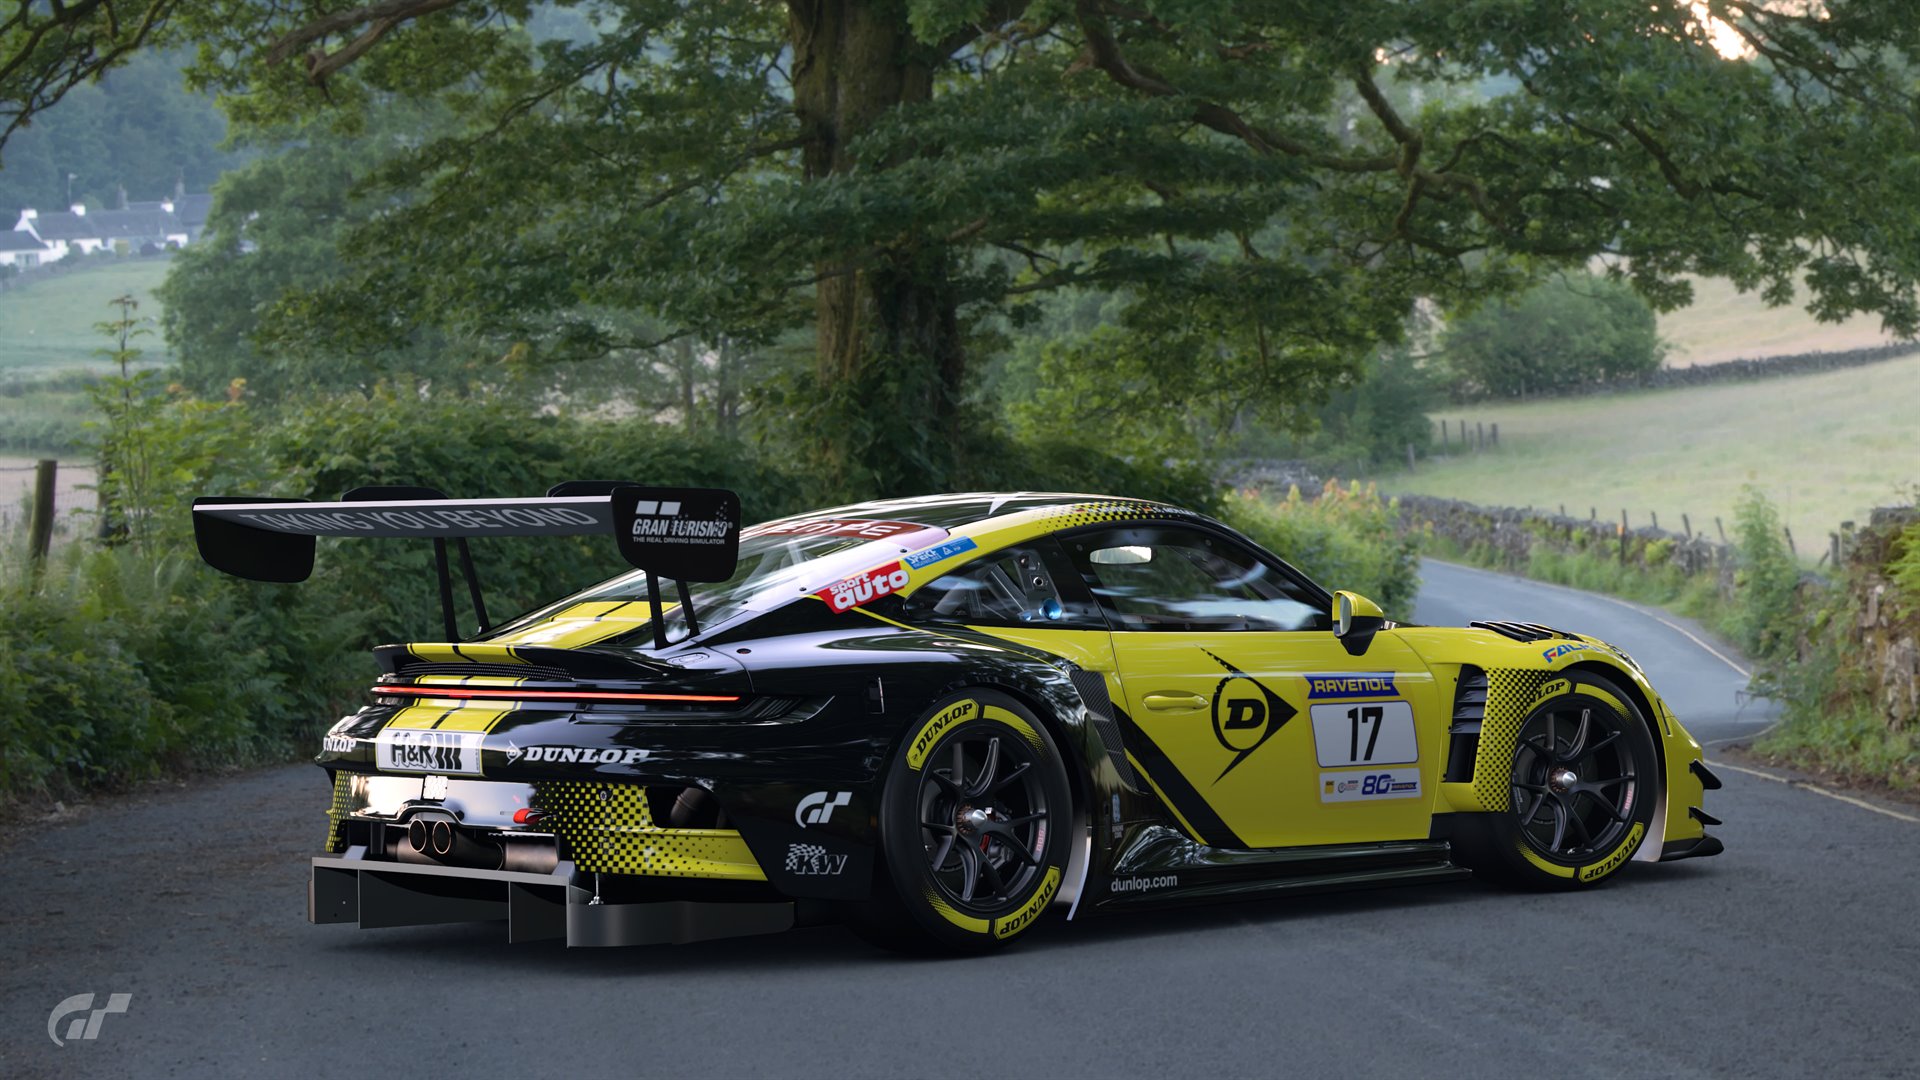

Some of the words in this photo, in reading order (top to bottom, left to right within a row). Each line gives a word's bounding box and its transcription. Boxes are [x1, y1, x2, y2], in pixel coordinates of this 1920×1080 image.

[238, 512, 375, 530] TAKING
[356, 511, 449, 530] YOU
[433, 507, 599, 528] BEYOND
[632, 518, 670, 536] GRAN
[632, 536, 646, 544] THE
[646, 536, 662, 544] REAL
[663, 537, 689, 545] DRIVING
[689, 538, 726, 546] SIMULATOR
[829, 572, 870, 596] sport
[833, 569, 910, 610] auto
[1313, 678, 1392, 693] RAVENOL
[916, 702, 973, 756] DUNLOP
[1347, 706, 1384, 762] 17
[391, 731, 438, 770] H&R
[523, 746, 651, 764] DUNLOP
[1361, 774, 1392, 796] 80
[793, 852, 849, 875] KW
[1583, 834, 1639, 880] DUNLOP
[1110, 875, 1178, 893] dunlop.com
[999, 880, 1054, 935] DUNLOP
